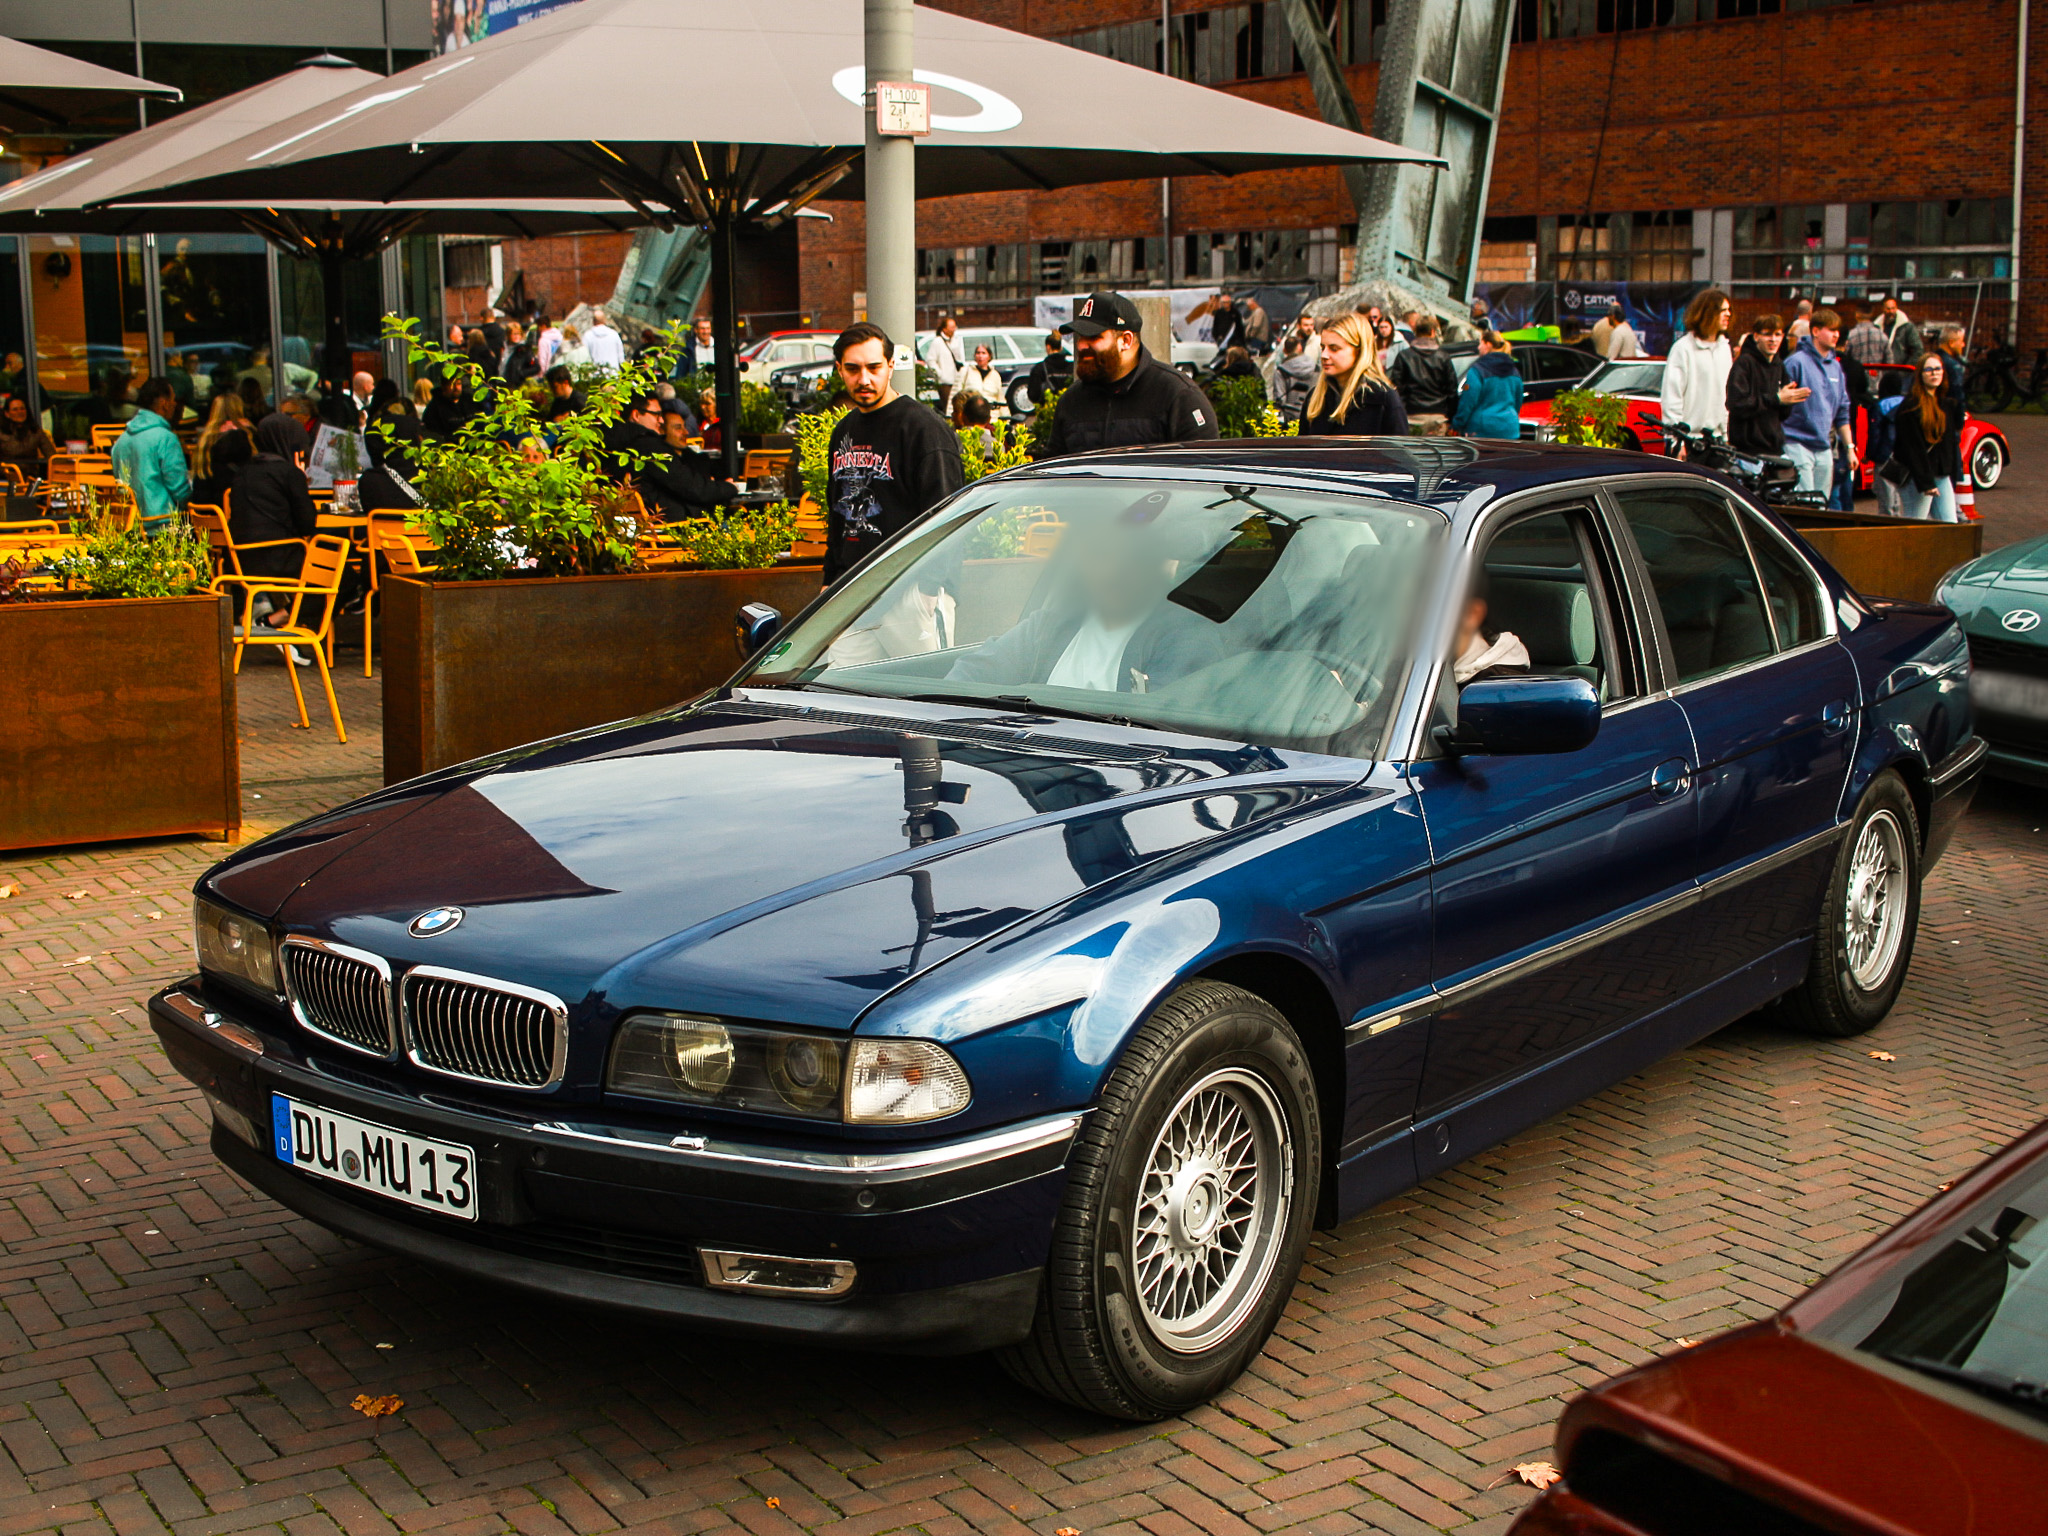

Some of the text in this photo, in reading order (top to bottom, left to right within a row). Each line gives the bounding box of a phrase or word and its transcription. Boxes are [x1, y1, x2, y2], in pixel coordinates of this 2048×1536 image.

[885, 89, 917, 101] H 100
[280, 1137, 288, 1151] D
[293, 1109, 471, 1209] DU MU 13
